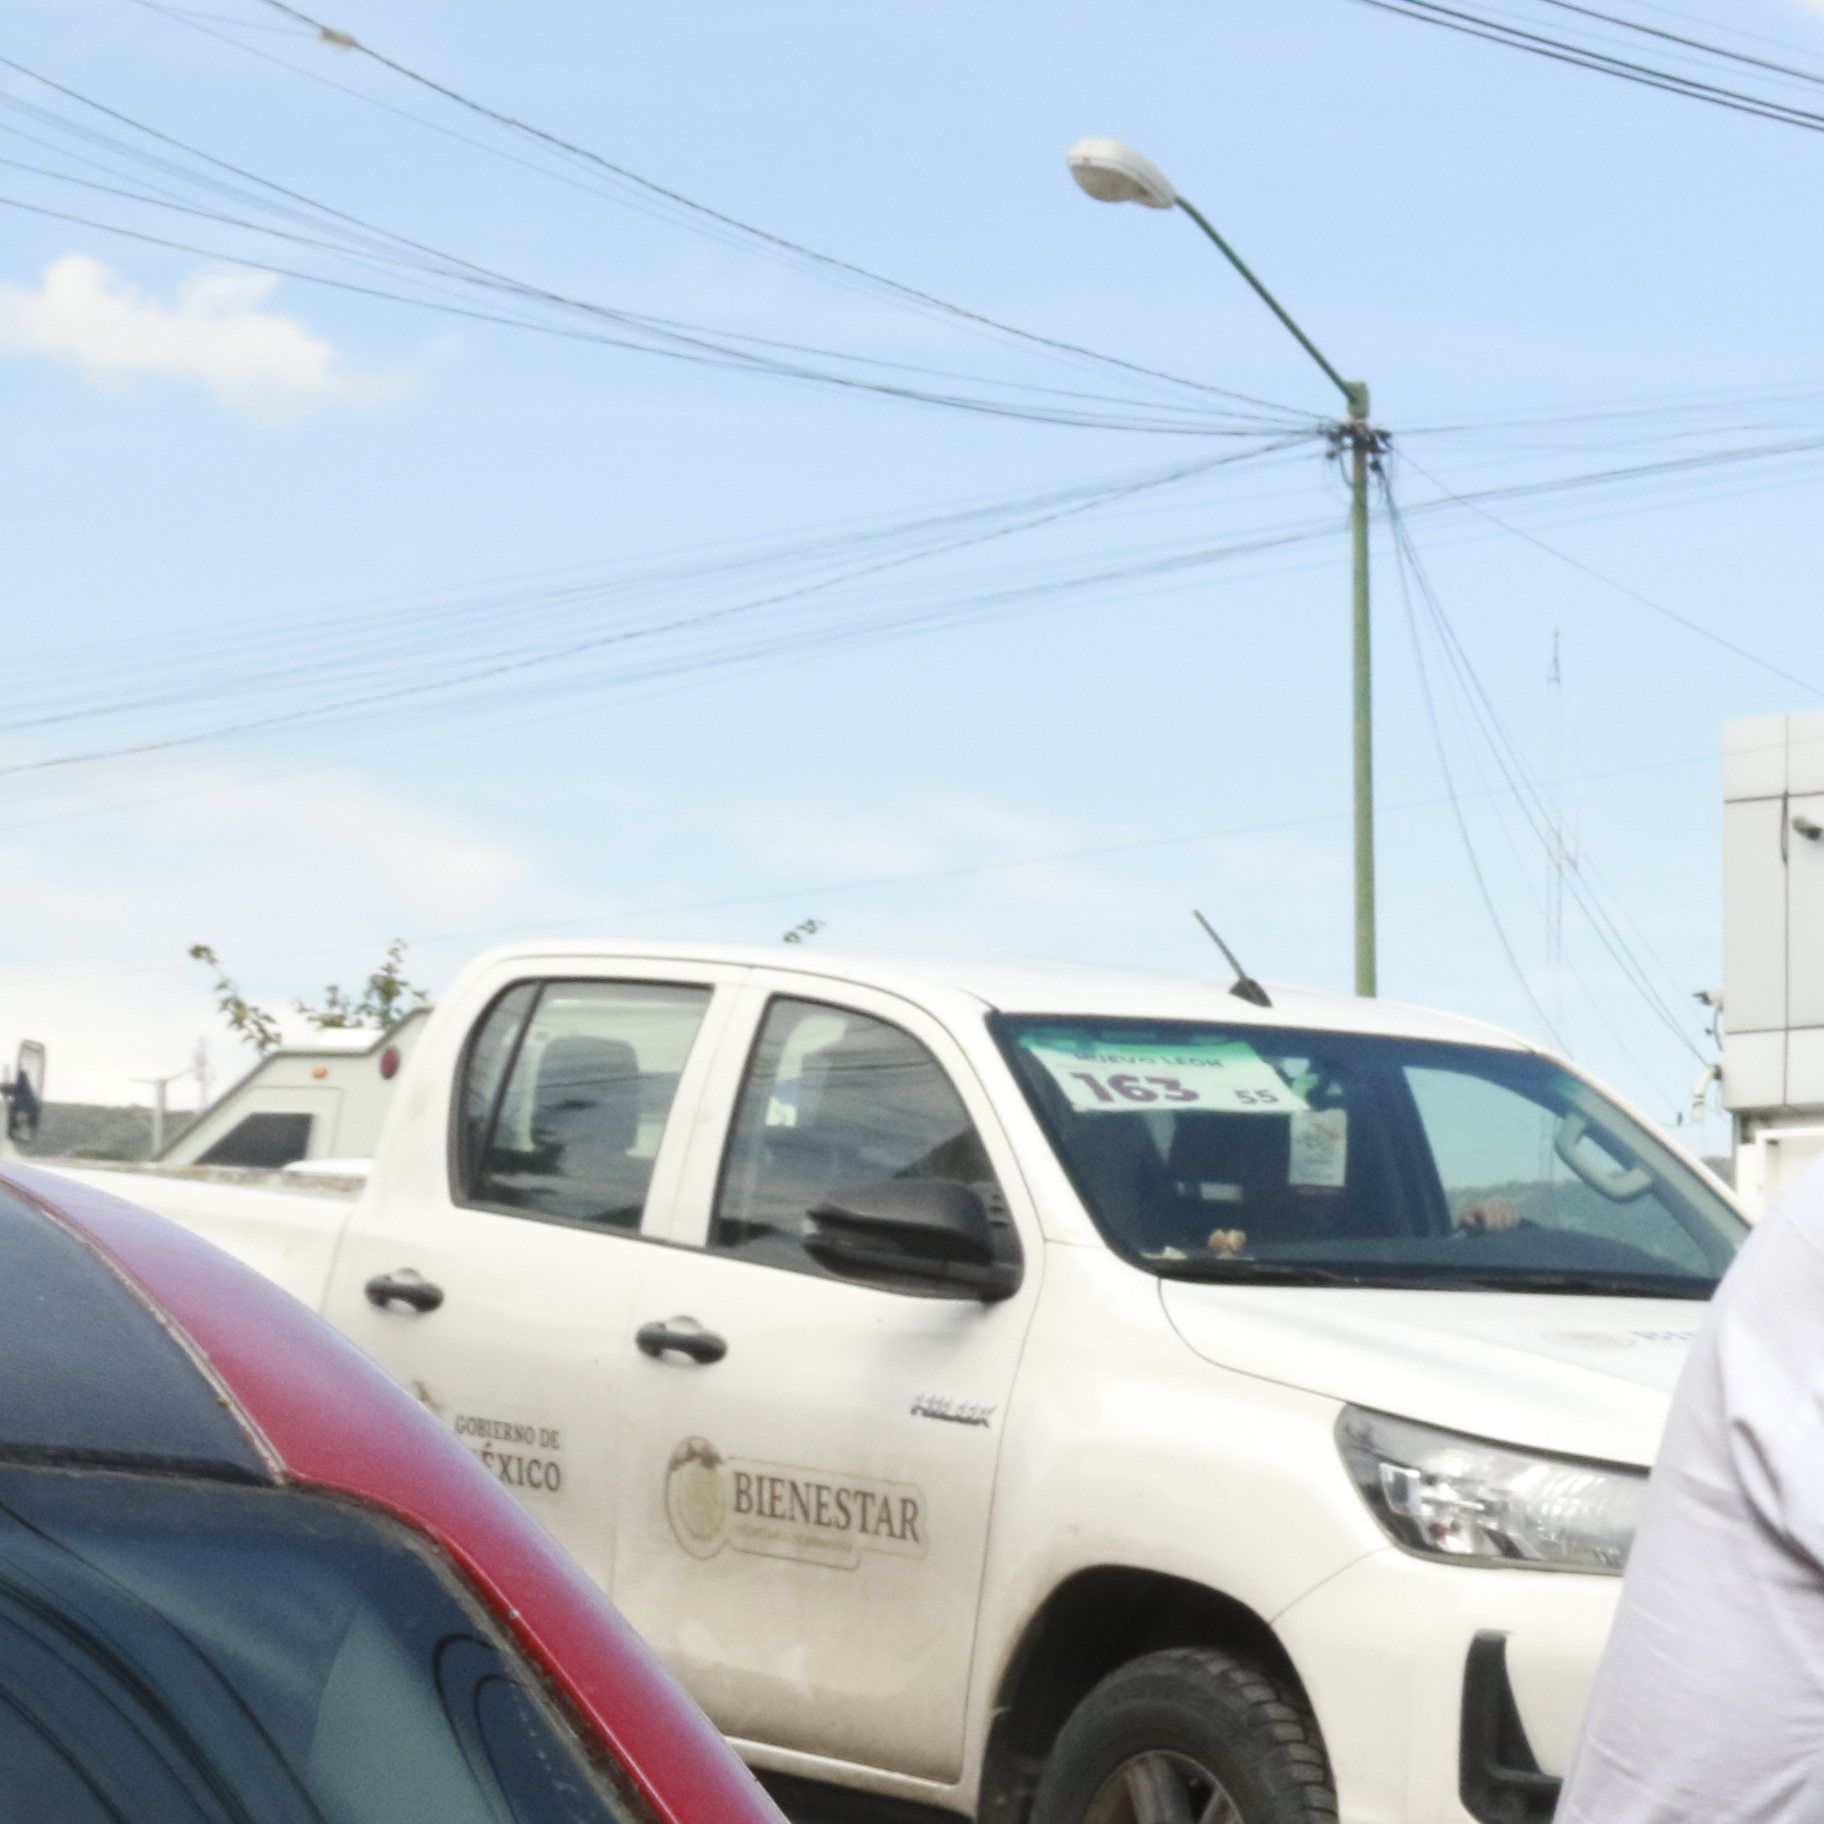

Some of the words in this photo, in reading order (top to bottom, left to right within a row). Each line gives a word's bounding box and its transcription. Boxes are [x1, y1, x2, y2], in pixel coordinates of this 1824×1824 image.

[1069, 1070, 1200, 1103] 163
[1234, 1089, 1279, 1105] 55
[454, 1415, 536, 1446] GOBIERNO
[539, 1428, 561, 1450] DE
[471, 1440, 562, 1492] ÉXICO
[733, 1471, 921, 1543] BIENESTAR
